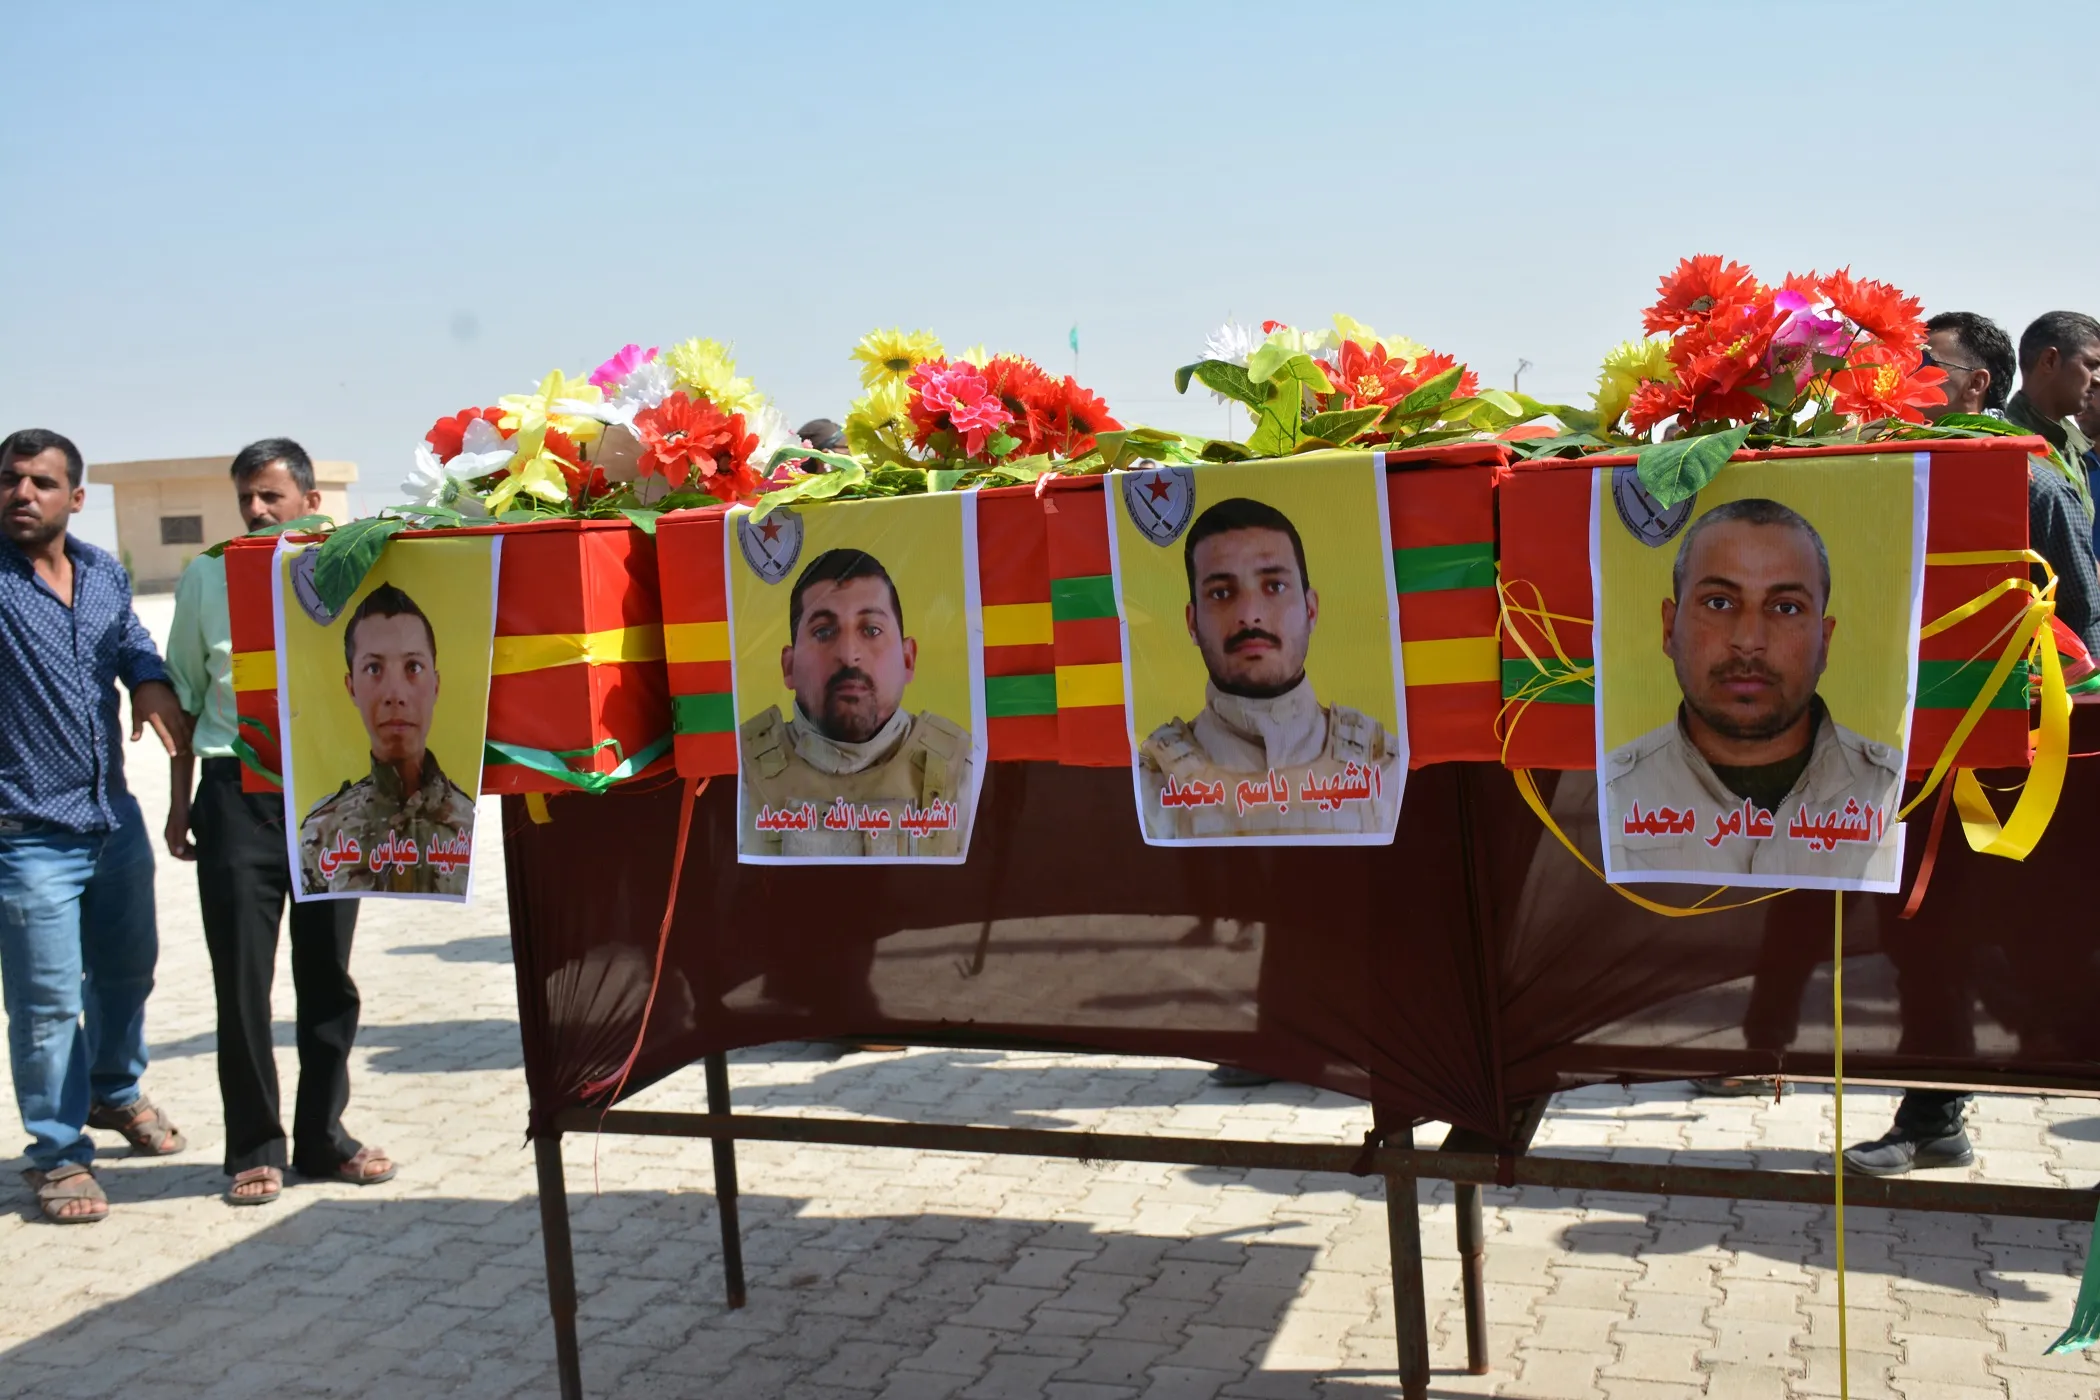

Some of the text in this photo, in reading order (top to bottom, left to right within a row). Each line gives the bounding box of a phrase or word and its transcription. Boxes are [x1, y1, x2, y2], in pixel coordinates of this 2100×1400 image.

[1161, 760, 1381, 817] الشهيد باسم محمد
[756, 802, 817, 832] المحمد
[899, 798, 958, 838] الشهيد
[1623, 796, 1884, 851] الشهيد عامر محمد
[319, 828, 472, 879] لشهيد عباس علي
